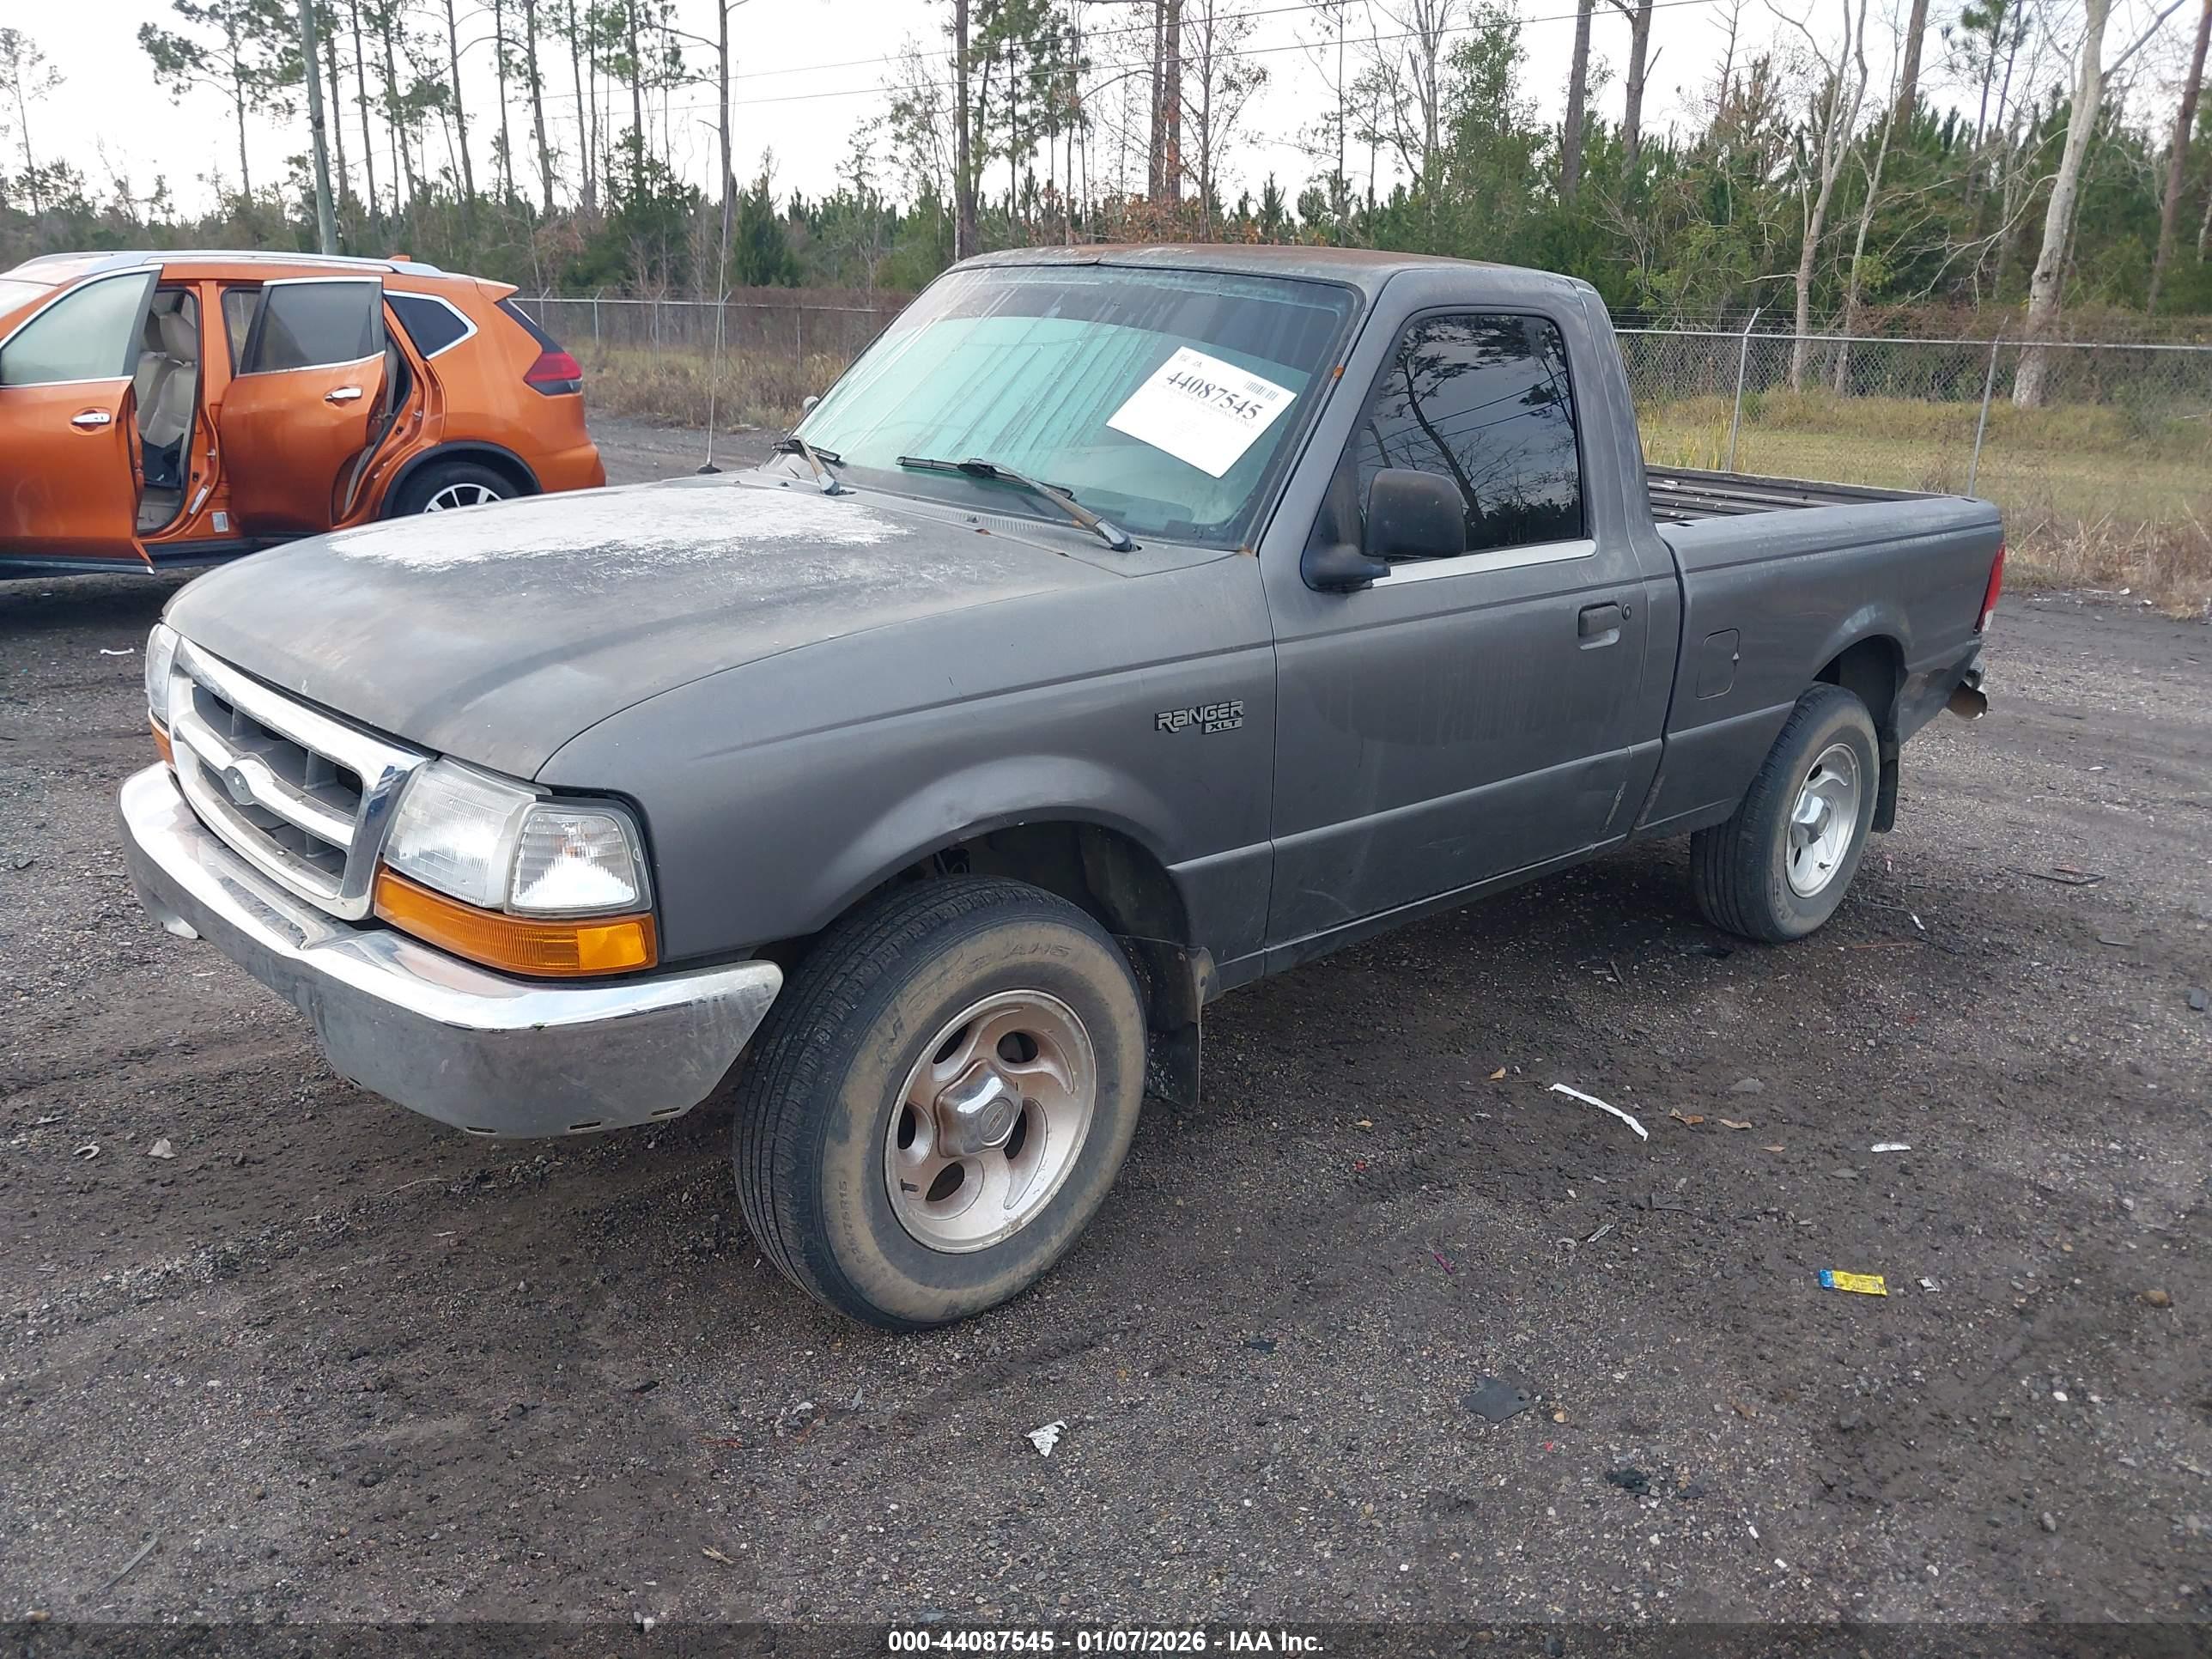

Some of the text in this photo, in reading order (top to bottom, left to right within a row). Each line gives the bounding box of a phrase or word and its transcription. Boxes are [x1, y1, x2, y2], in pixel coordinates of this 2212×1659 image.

[1167, 371, 1263, 420] 44087545
[1155, 700, 1244, 732] RANGER
[1205, 718, 1242, 732] XLT
